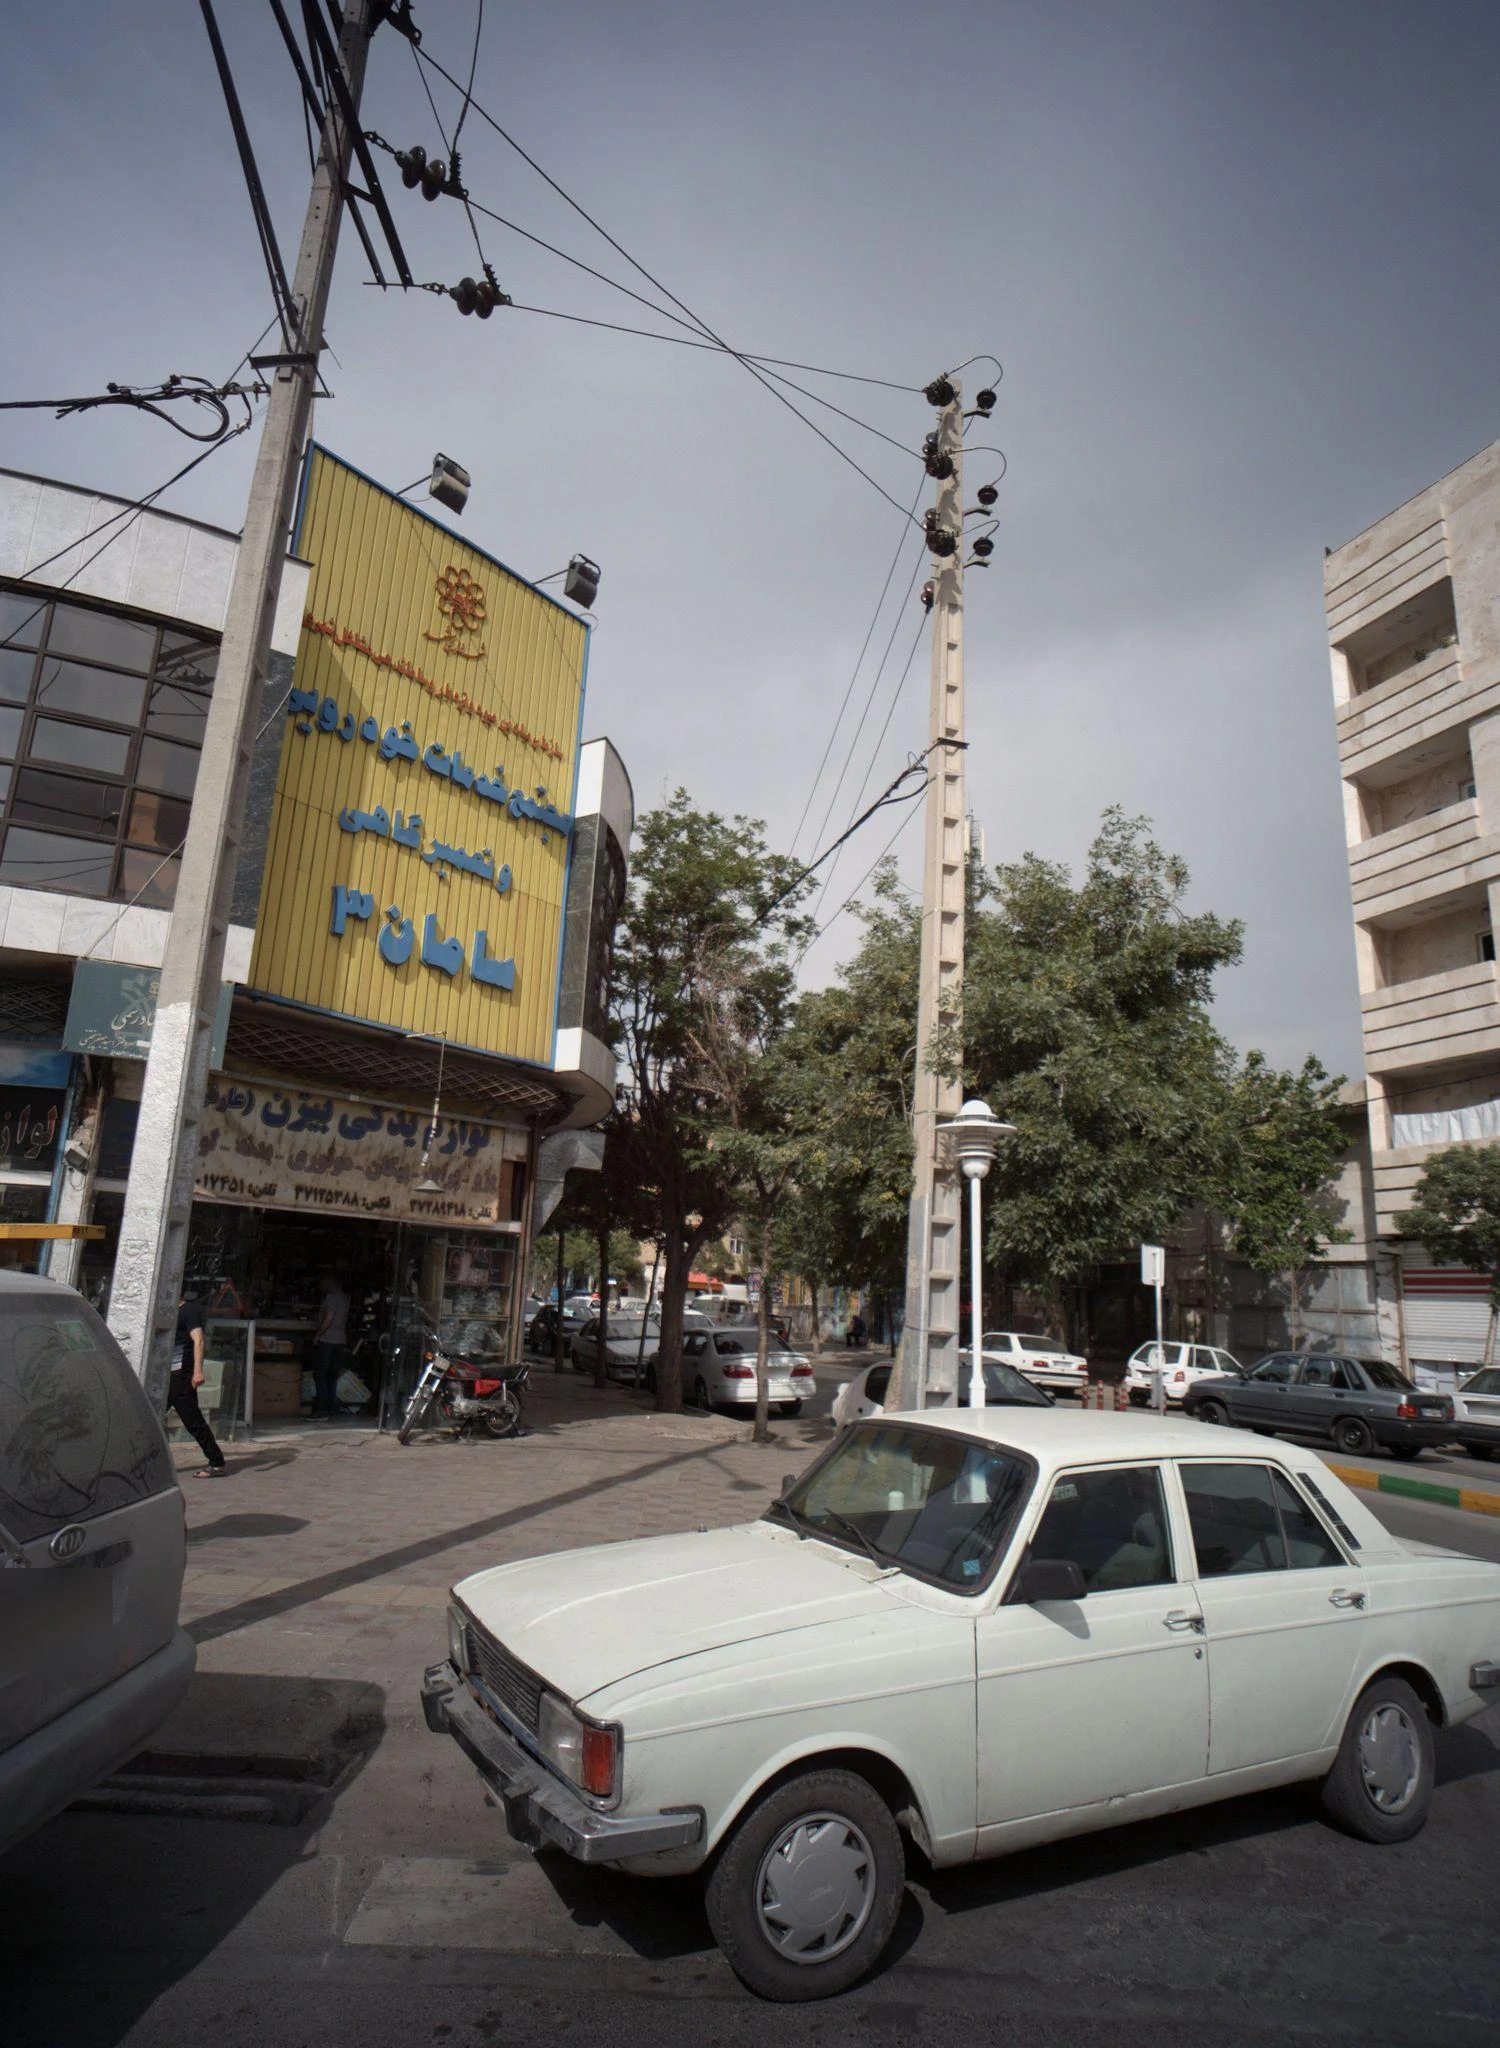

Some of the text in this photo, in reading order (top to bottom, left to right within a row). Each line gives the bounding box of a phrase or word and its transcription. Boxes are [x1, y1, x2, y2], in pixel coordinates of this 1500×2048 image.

[423, 742, 509, 805] خدمات
[495, 863, 513, 894] و
[331, 884, 517, 992] سامان ۳
[338, 1105, 418, 1148] یدکی
[421, 1115, 491, 1158] لوازم
